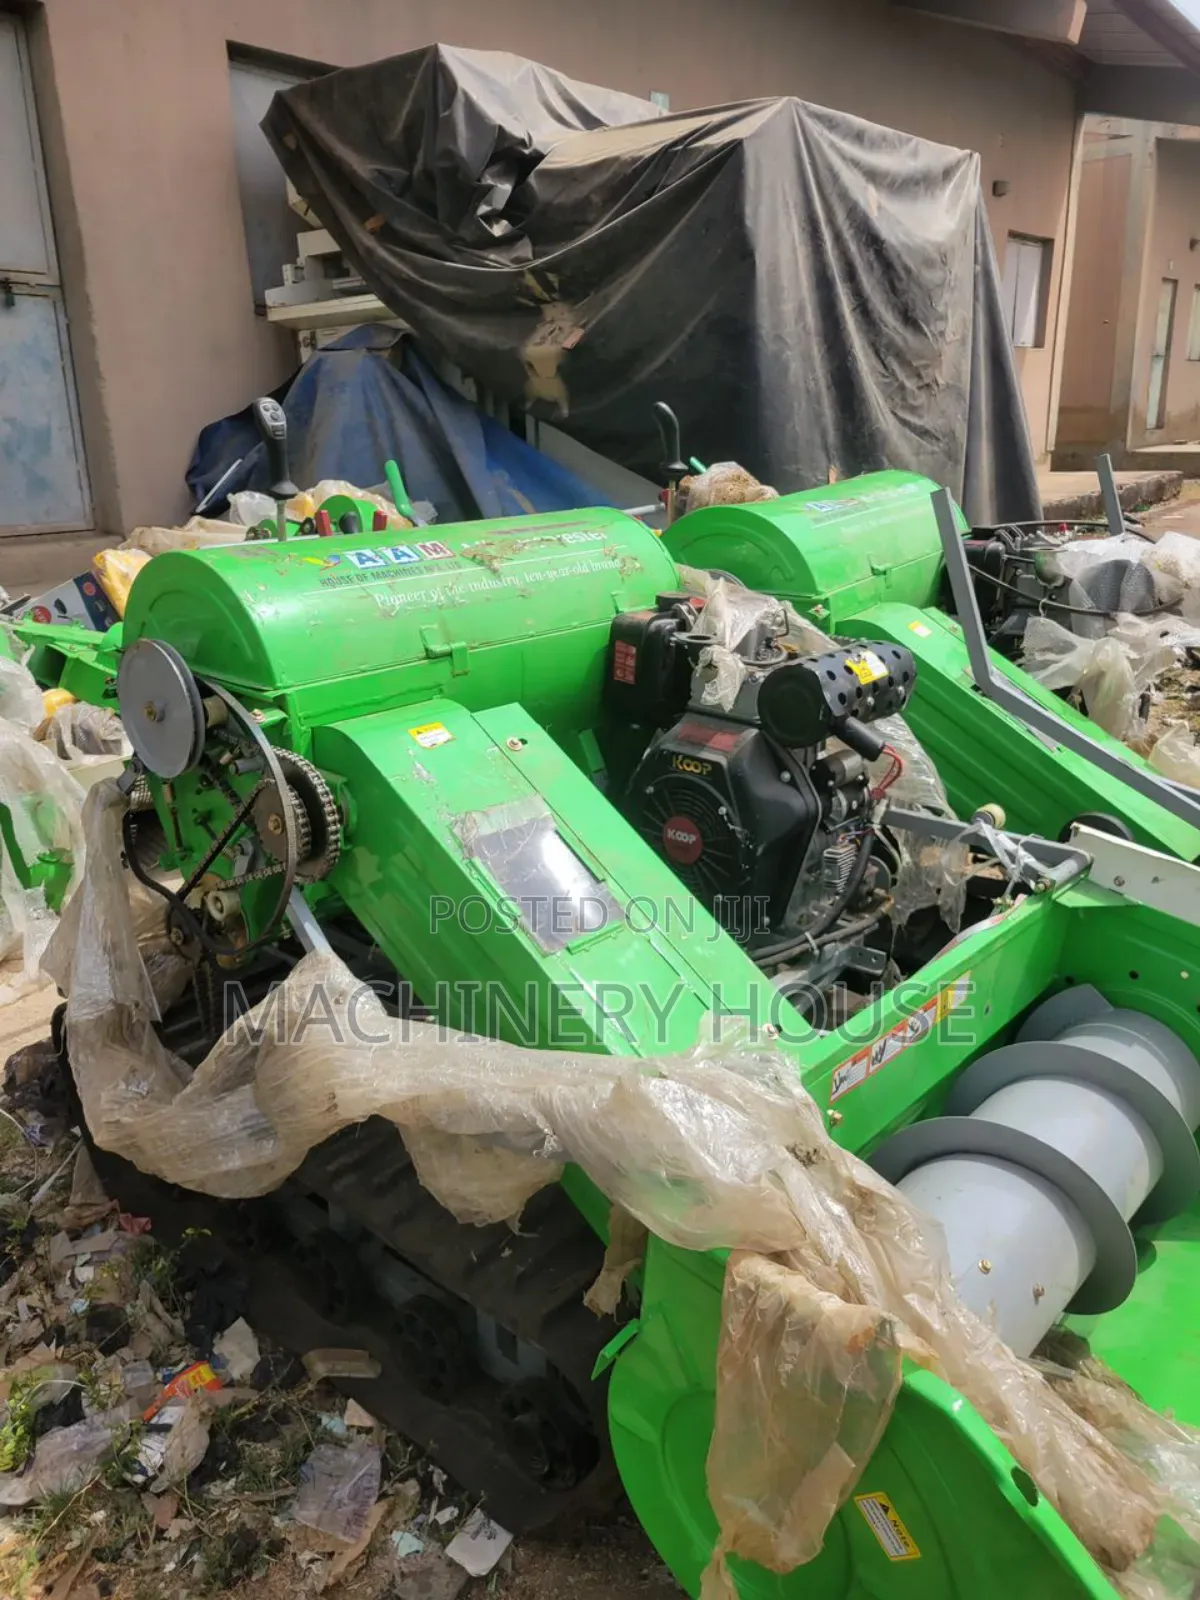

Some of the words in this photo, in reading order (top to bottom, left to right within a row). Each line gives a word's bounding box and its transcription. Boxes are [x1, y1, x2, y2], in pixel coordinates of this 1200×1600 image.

[320, 575, 354, 588] HOUSE
[355, 573, 369, 583] OF
[372, 565, 425, 581] MACHINES
[373, 589, 426, 608] Pioneer
[672, 754, 712, 776] KOOP
[667, 827, 698, 845] KOOP
